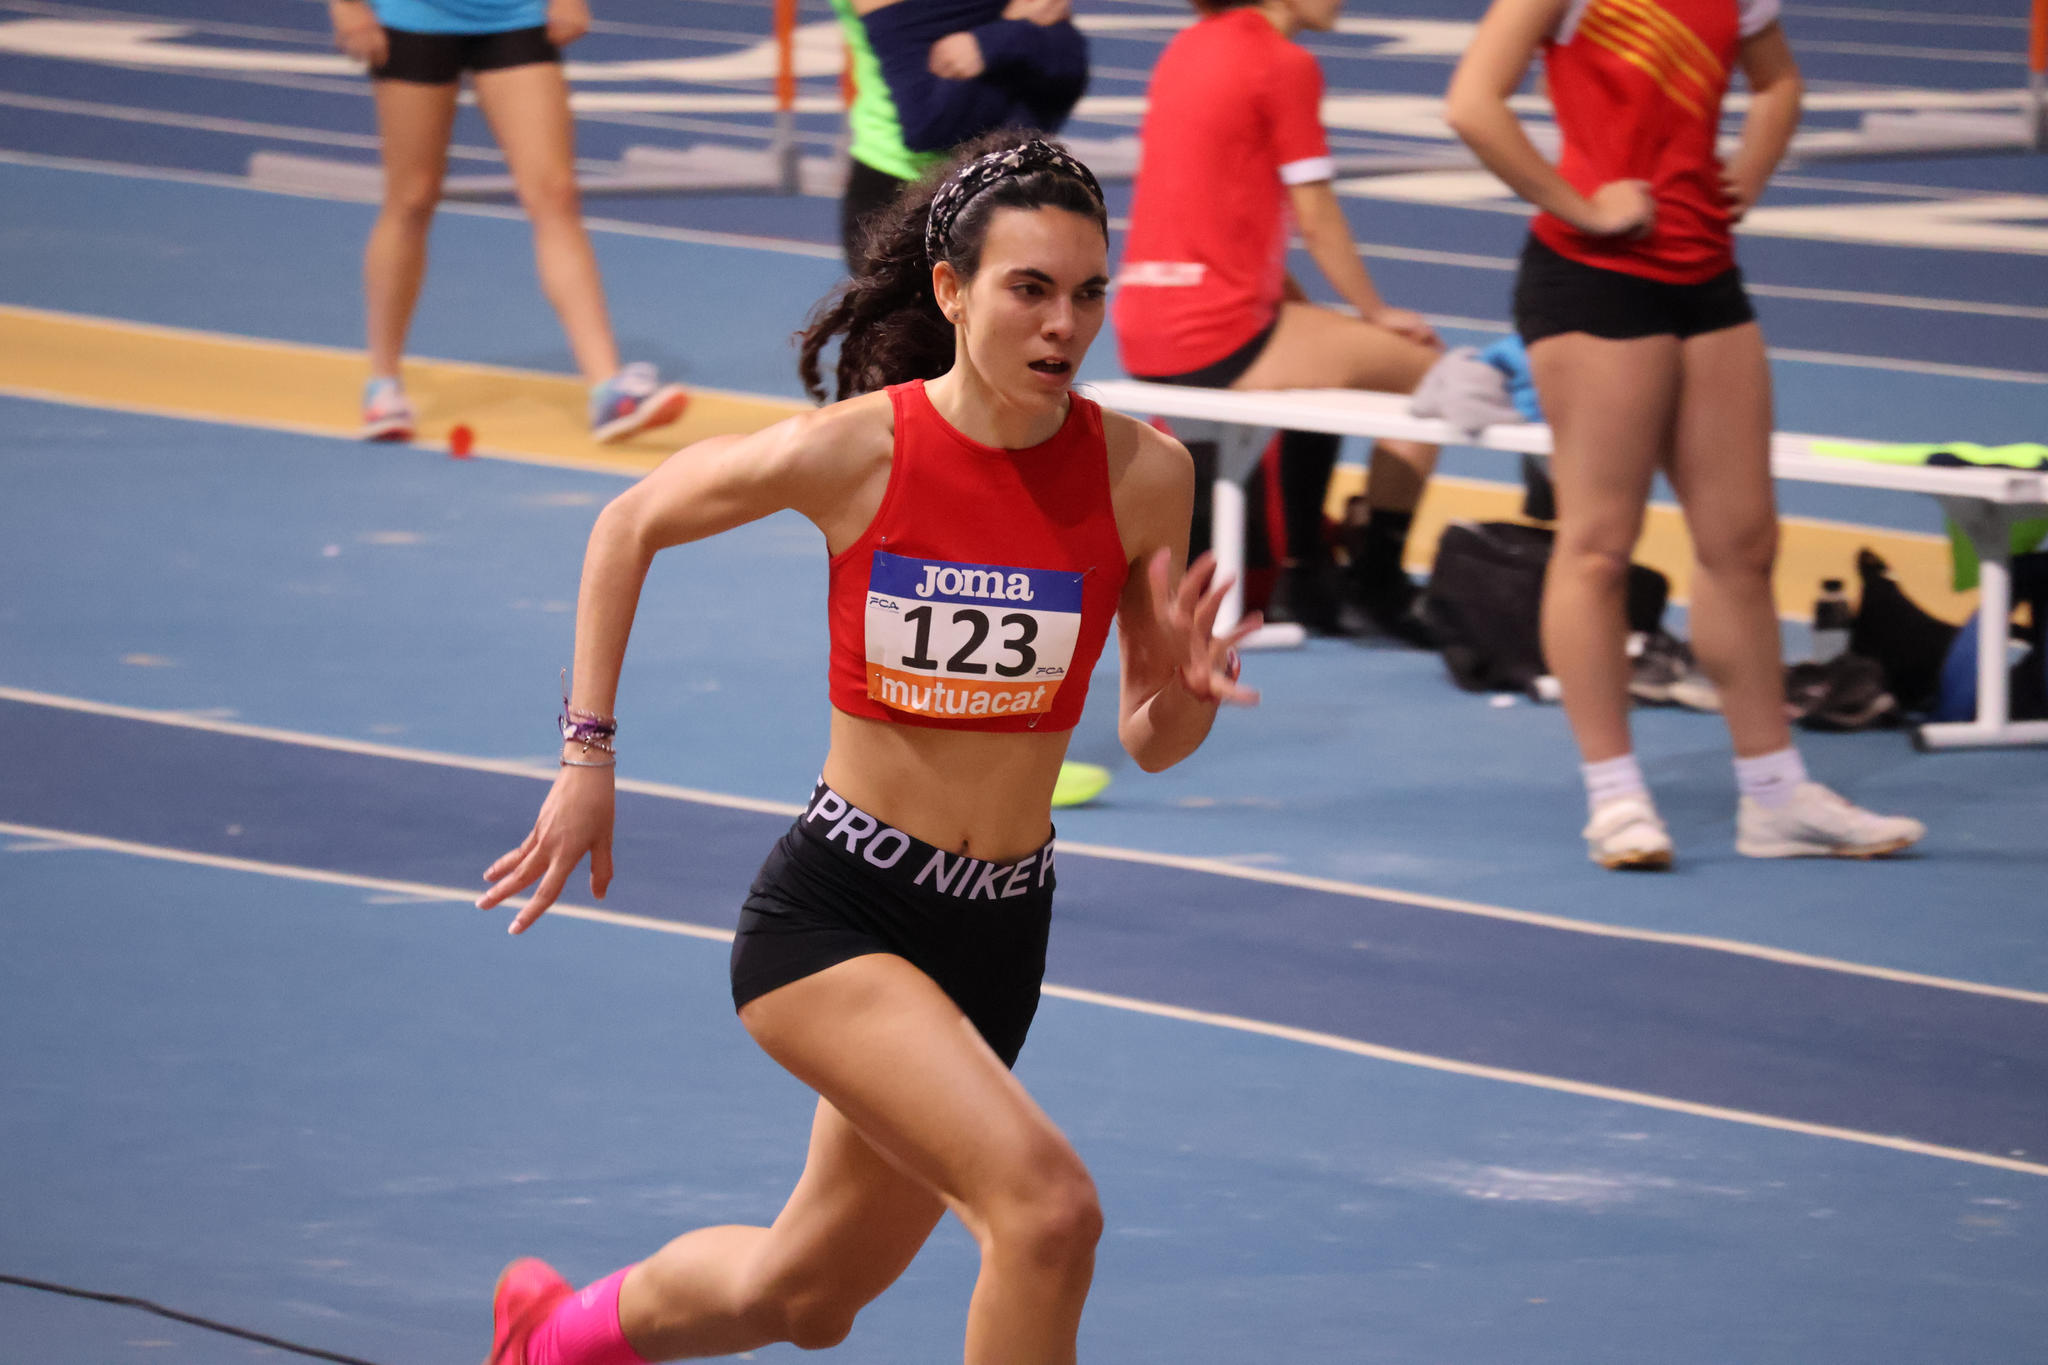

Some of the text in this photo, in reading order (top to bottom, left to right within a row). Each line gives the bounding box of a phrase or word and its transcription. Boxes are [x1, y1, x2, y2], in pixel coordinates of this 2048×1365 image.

[915, 565, 1034, 602] Joma
[901, 605, 1039, 677] 123
[881, 675, 1046, 715] mutuacat
[806, 789, 911, 869] PRO
[913, 849, 1036, 900] NIKE
